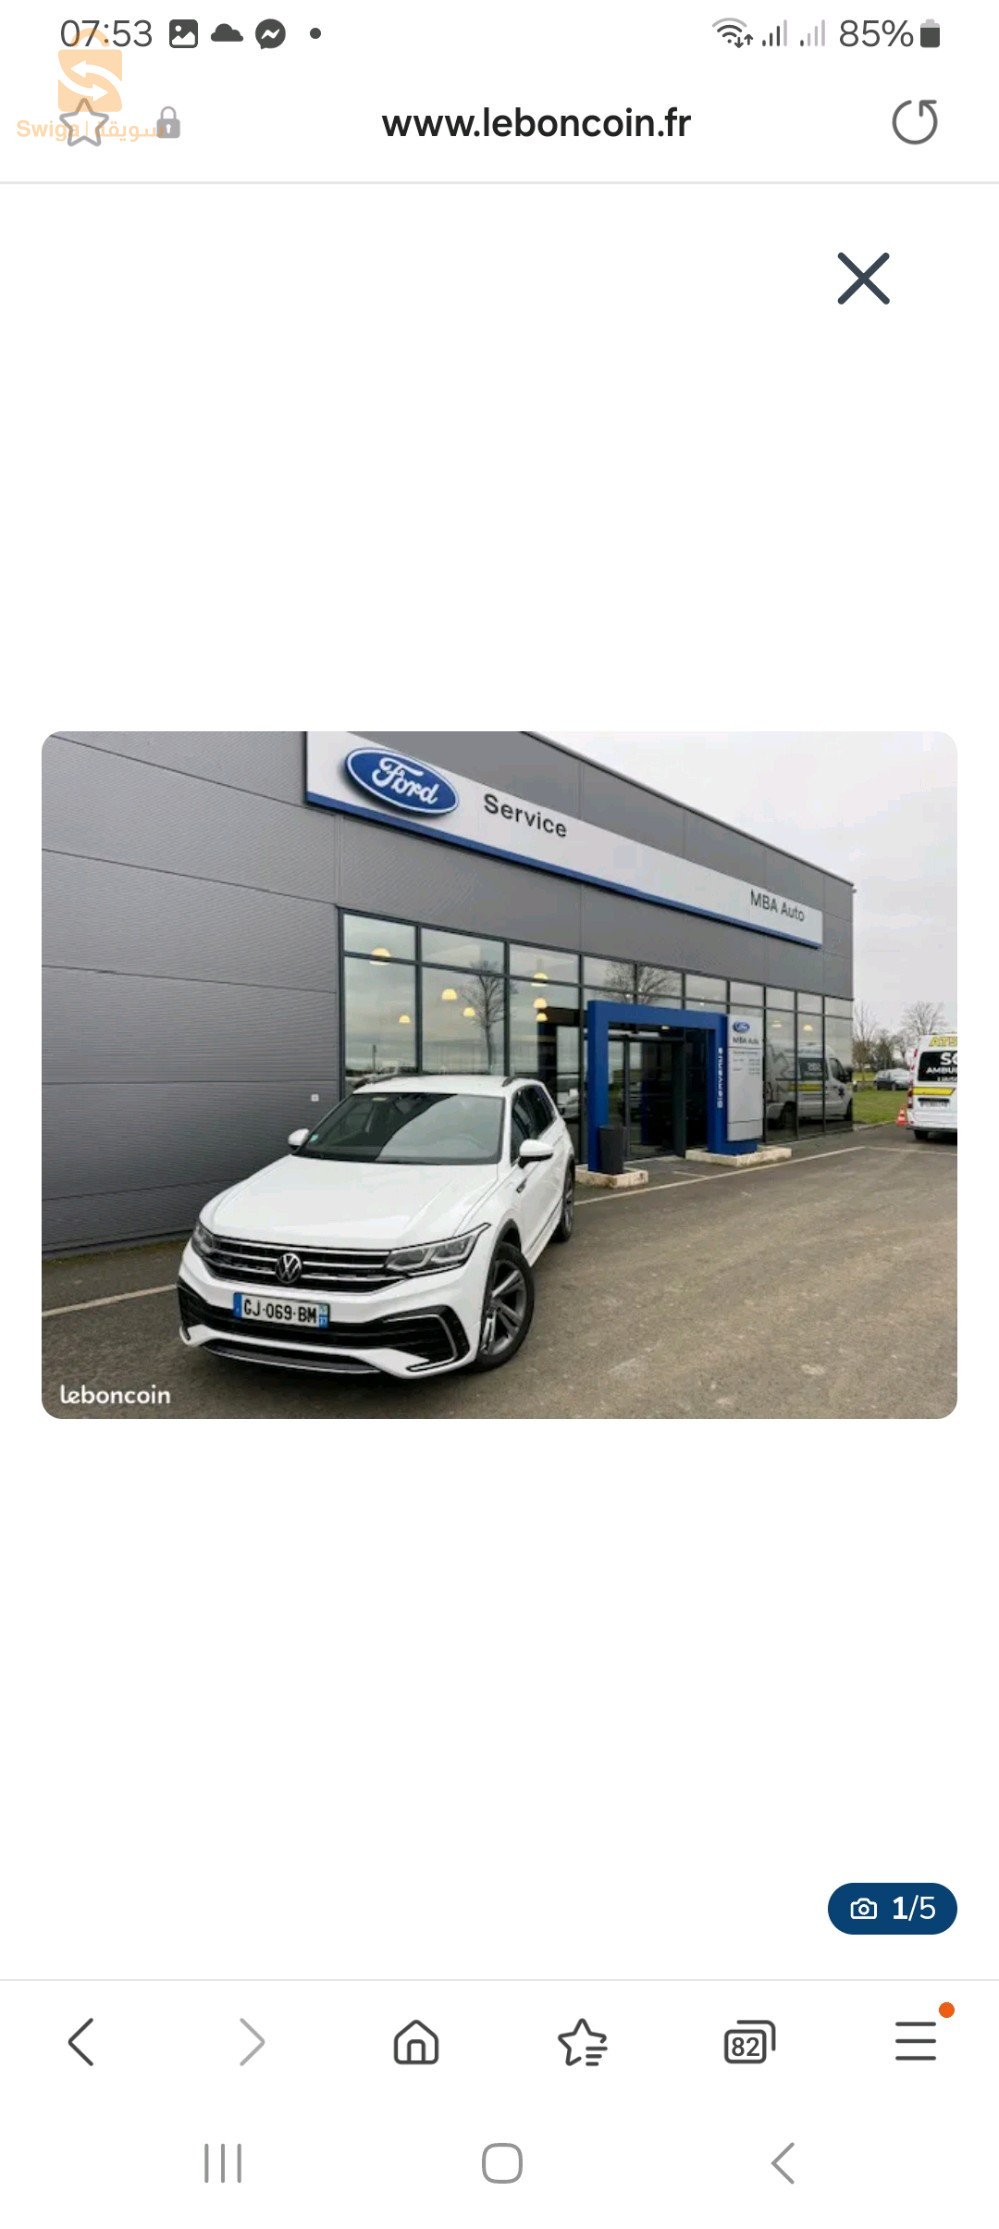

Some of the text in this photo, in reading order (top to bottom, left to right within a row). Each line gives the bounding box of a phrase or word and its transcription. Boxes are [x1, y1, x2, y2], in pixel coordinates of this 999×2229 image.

[60, 19, 153, 48] 07:53
[839, 19, 914, 48] 85%
[381, 106, 692, 138] www.leboncoin.fr
[372, 757, 440, 804] Ford
[483, 793, 568, 838] Service
[750, 889, 805, 922] MBA Auto
[892, 1895, 936, 1921] 1/5
[731, 2036, 760, 2057] 82
